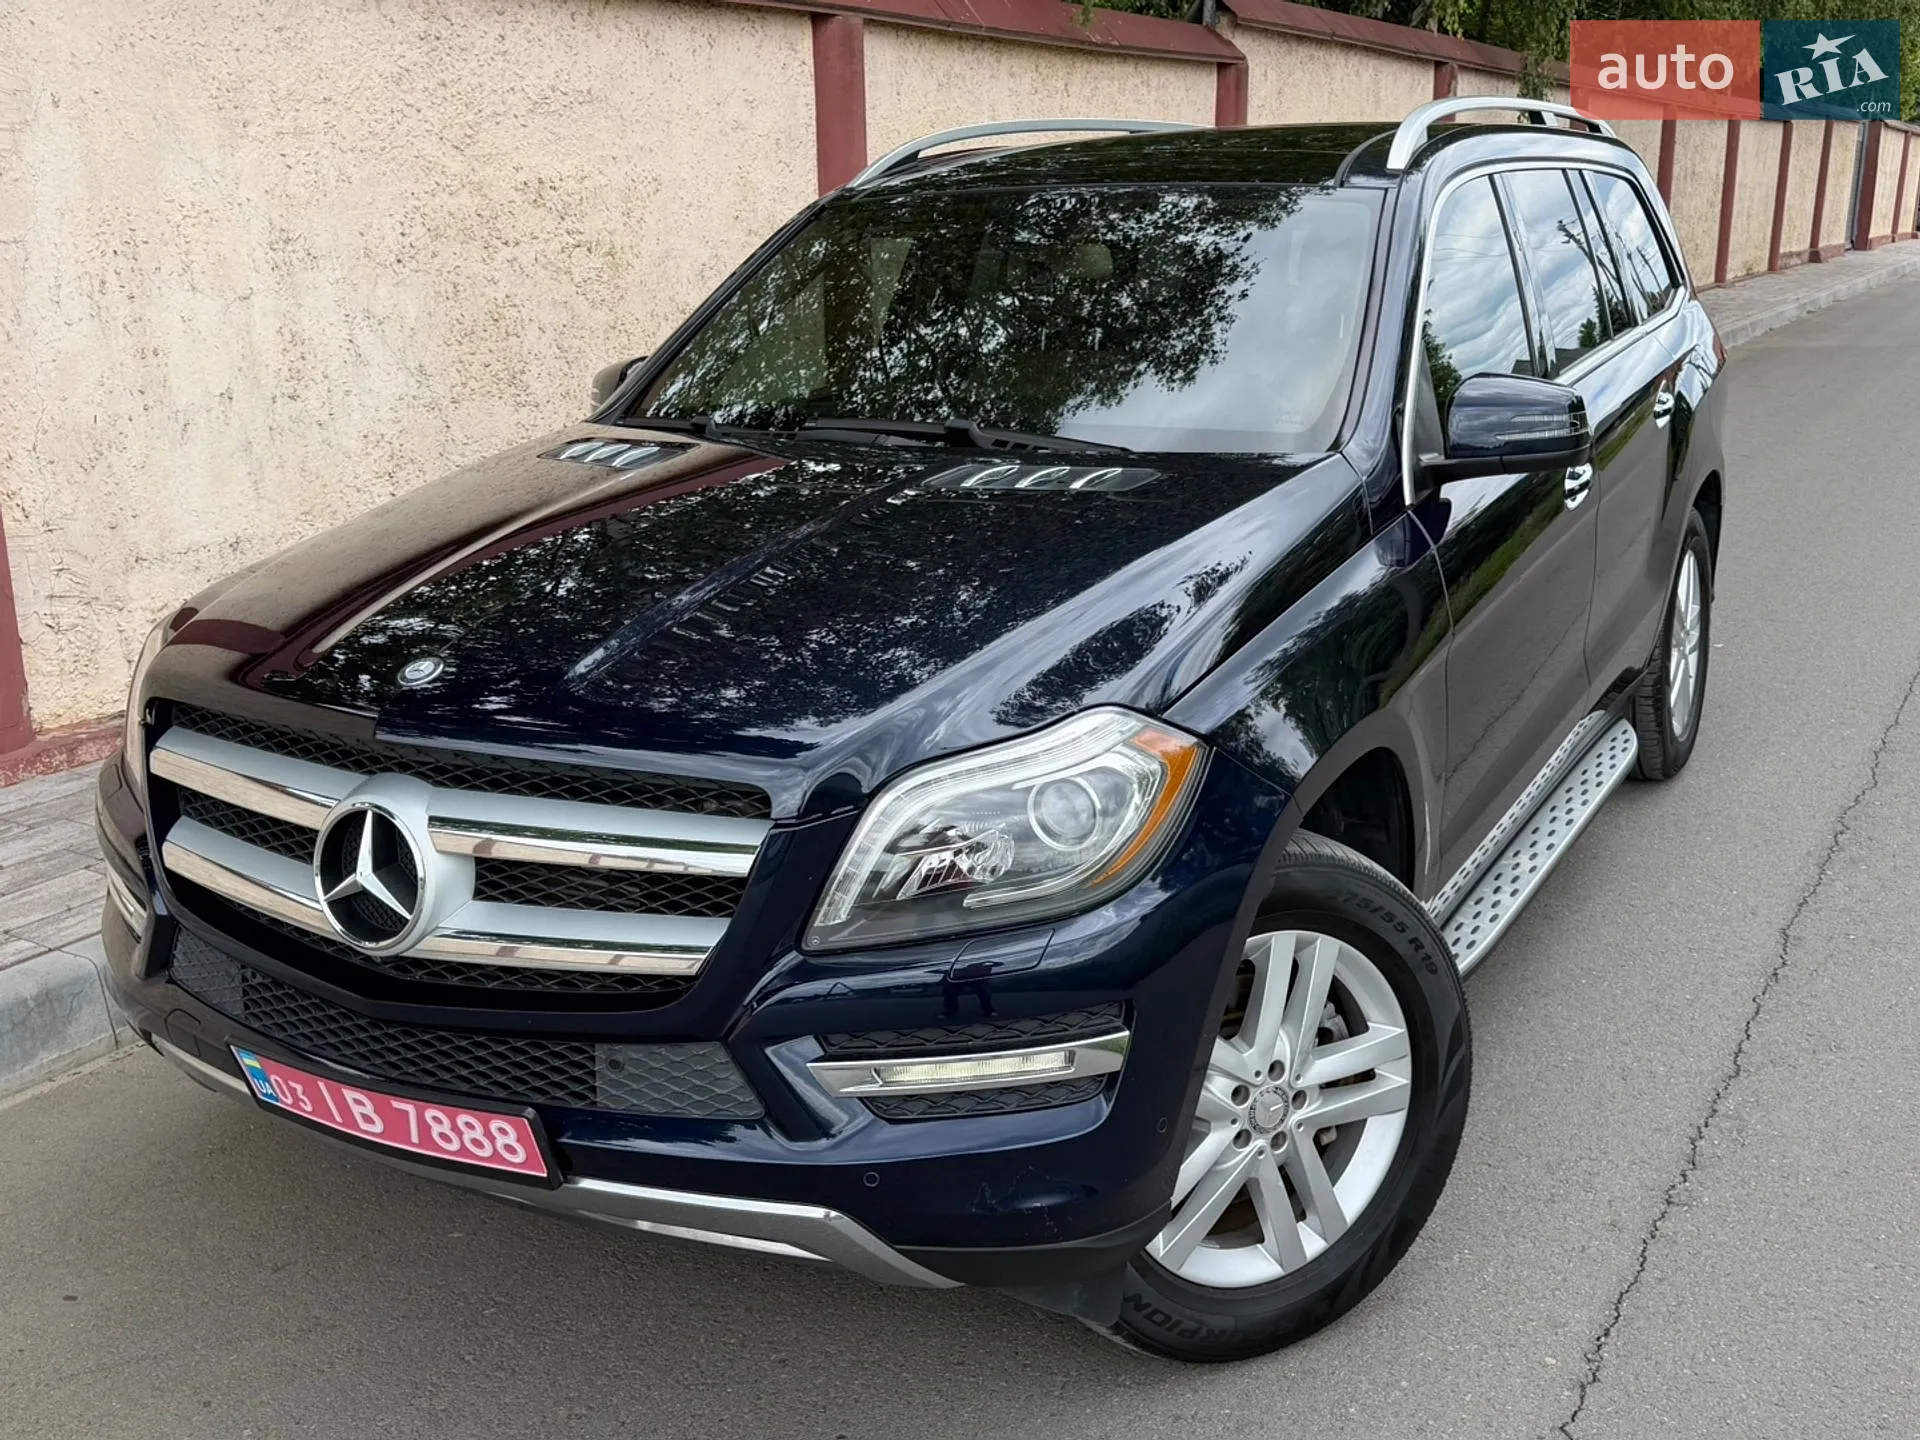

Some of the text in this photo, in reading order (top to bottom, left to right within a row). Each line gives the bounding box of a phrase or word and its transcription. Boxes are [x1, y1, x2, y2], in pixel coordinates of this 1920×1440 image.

[253, 1078, 277, 1097] UA
[270, 1074, 313, 1112] 03
[390, 1100, 527, 1164] 7888
